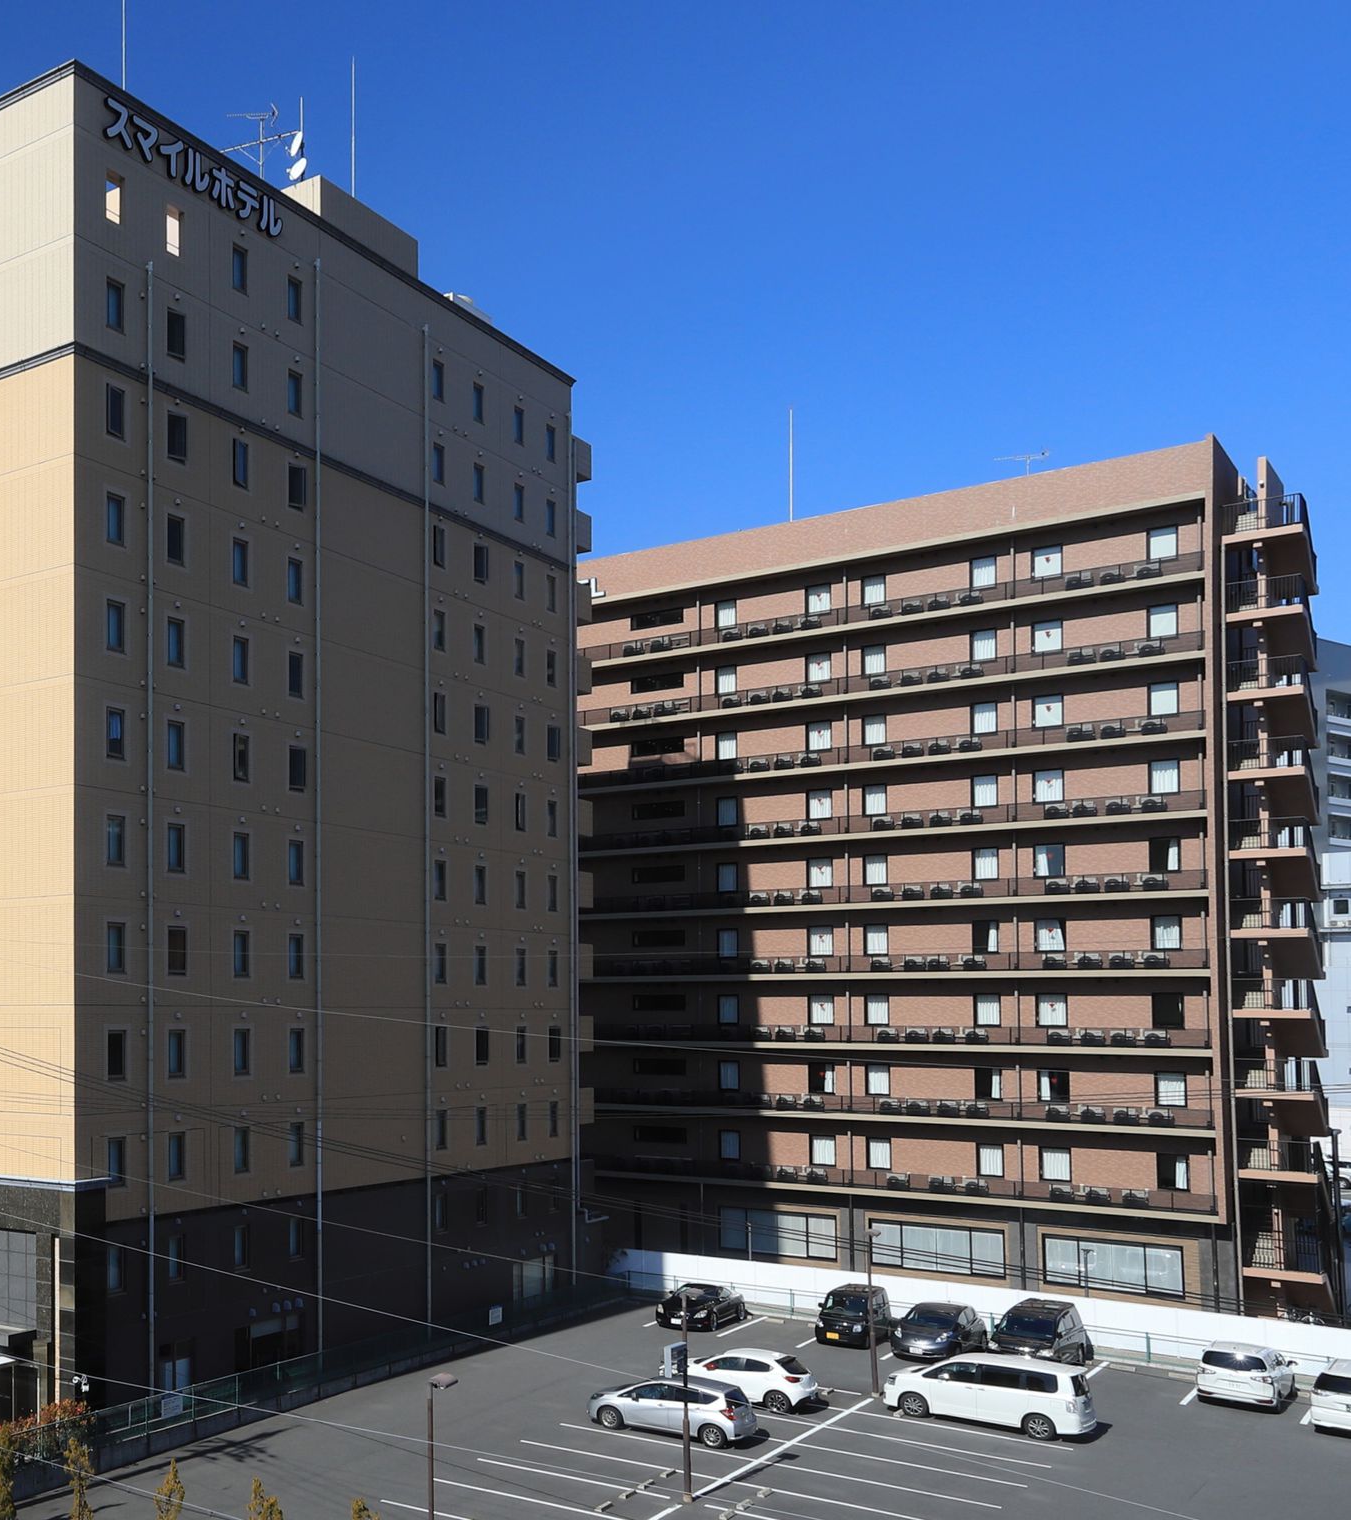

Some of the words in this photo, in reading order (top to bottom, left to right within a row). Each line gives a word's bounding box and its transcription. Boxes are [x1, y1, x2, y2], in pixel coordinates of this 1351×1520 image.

[104, 96, 284, 237] スマイルホテル
